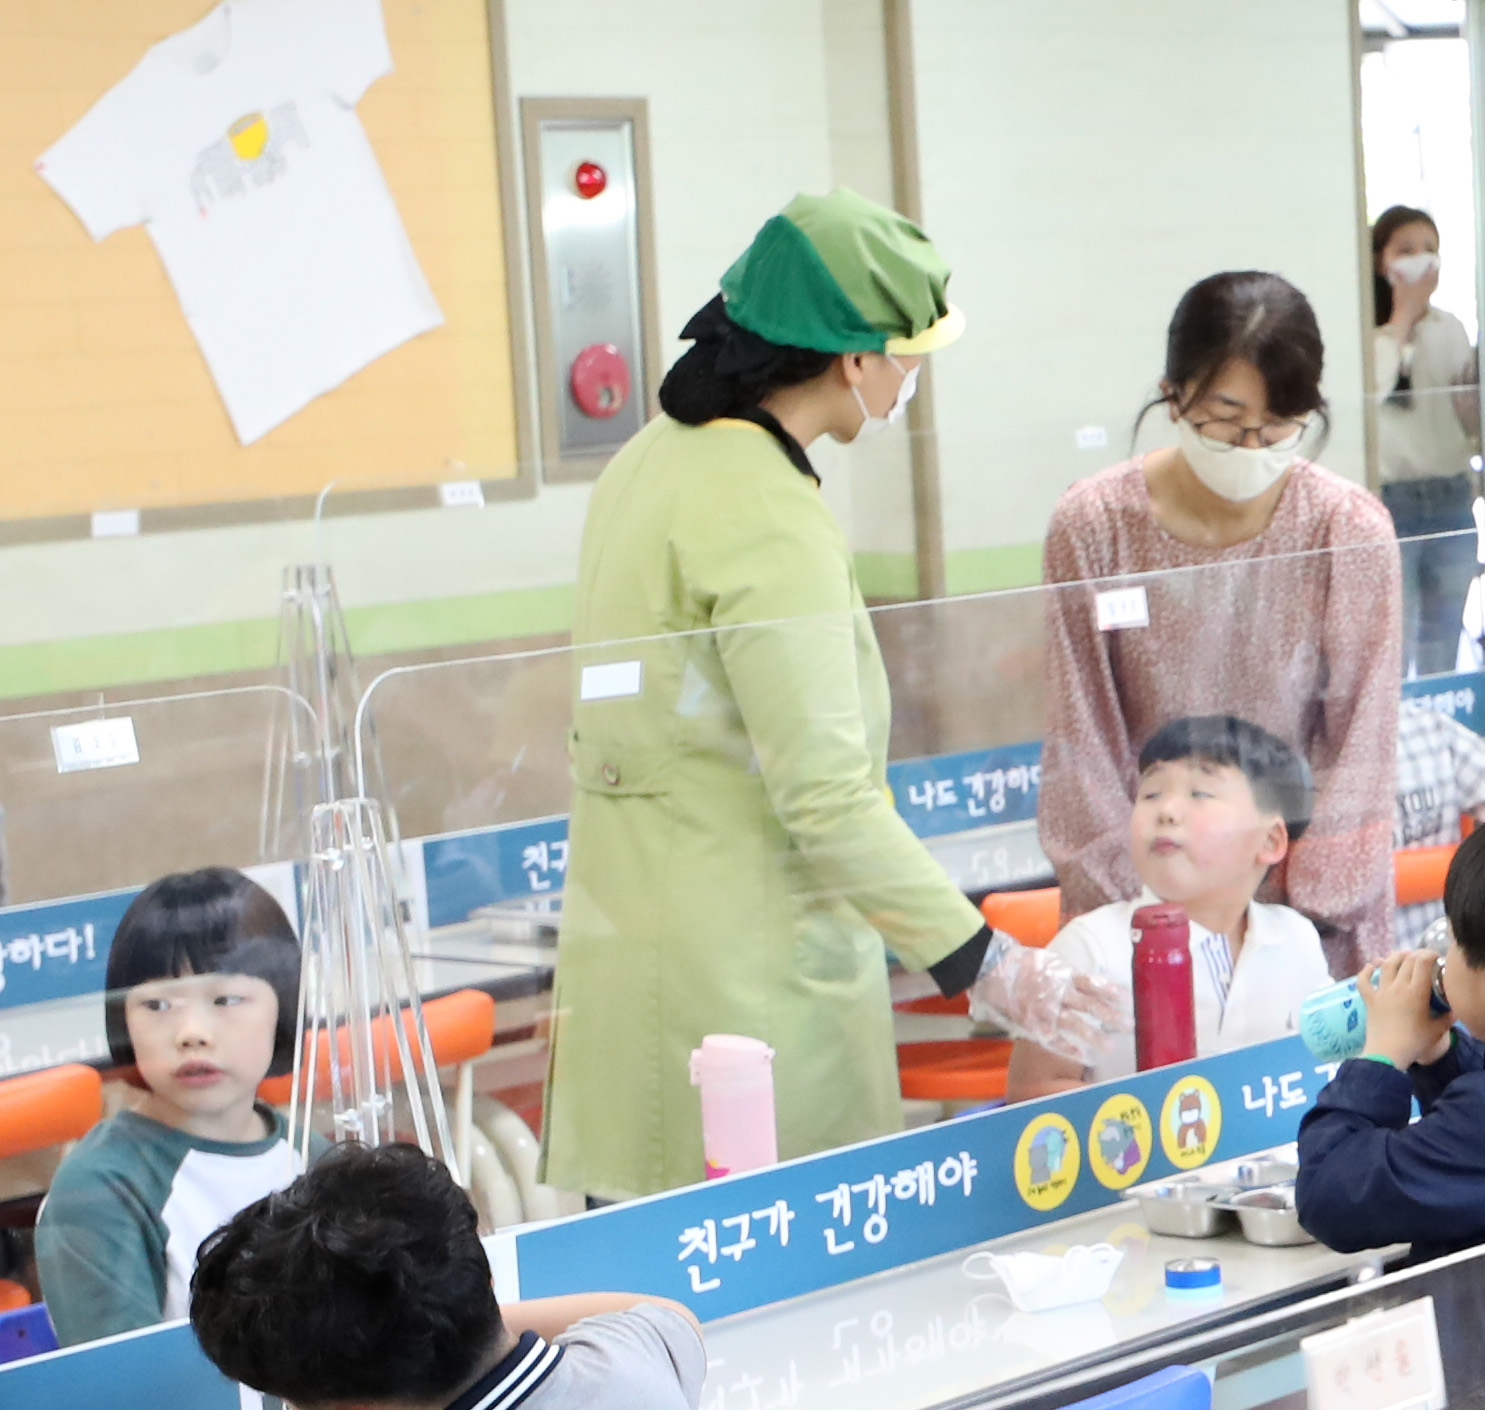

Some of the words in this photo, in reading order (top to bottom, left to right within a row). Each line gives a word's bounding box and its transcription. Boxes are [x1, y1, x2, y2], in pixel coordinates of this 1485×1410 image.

[908, 779, 958, 811] 나도
[522, 840, 569, 892] 친구
[0, 922, 96, 993] 하다!
[1241, 1070, 1307, 1119] 나도
[677, 1199, 796, 1293] 친구가
[814, 1150, 979, 1256] 건강해야
